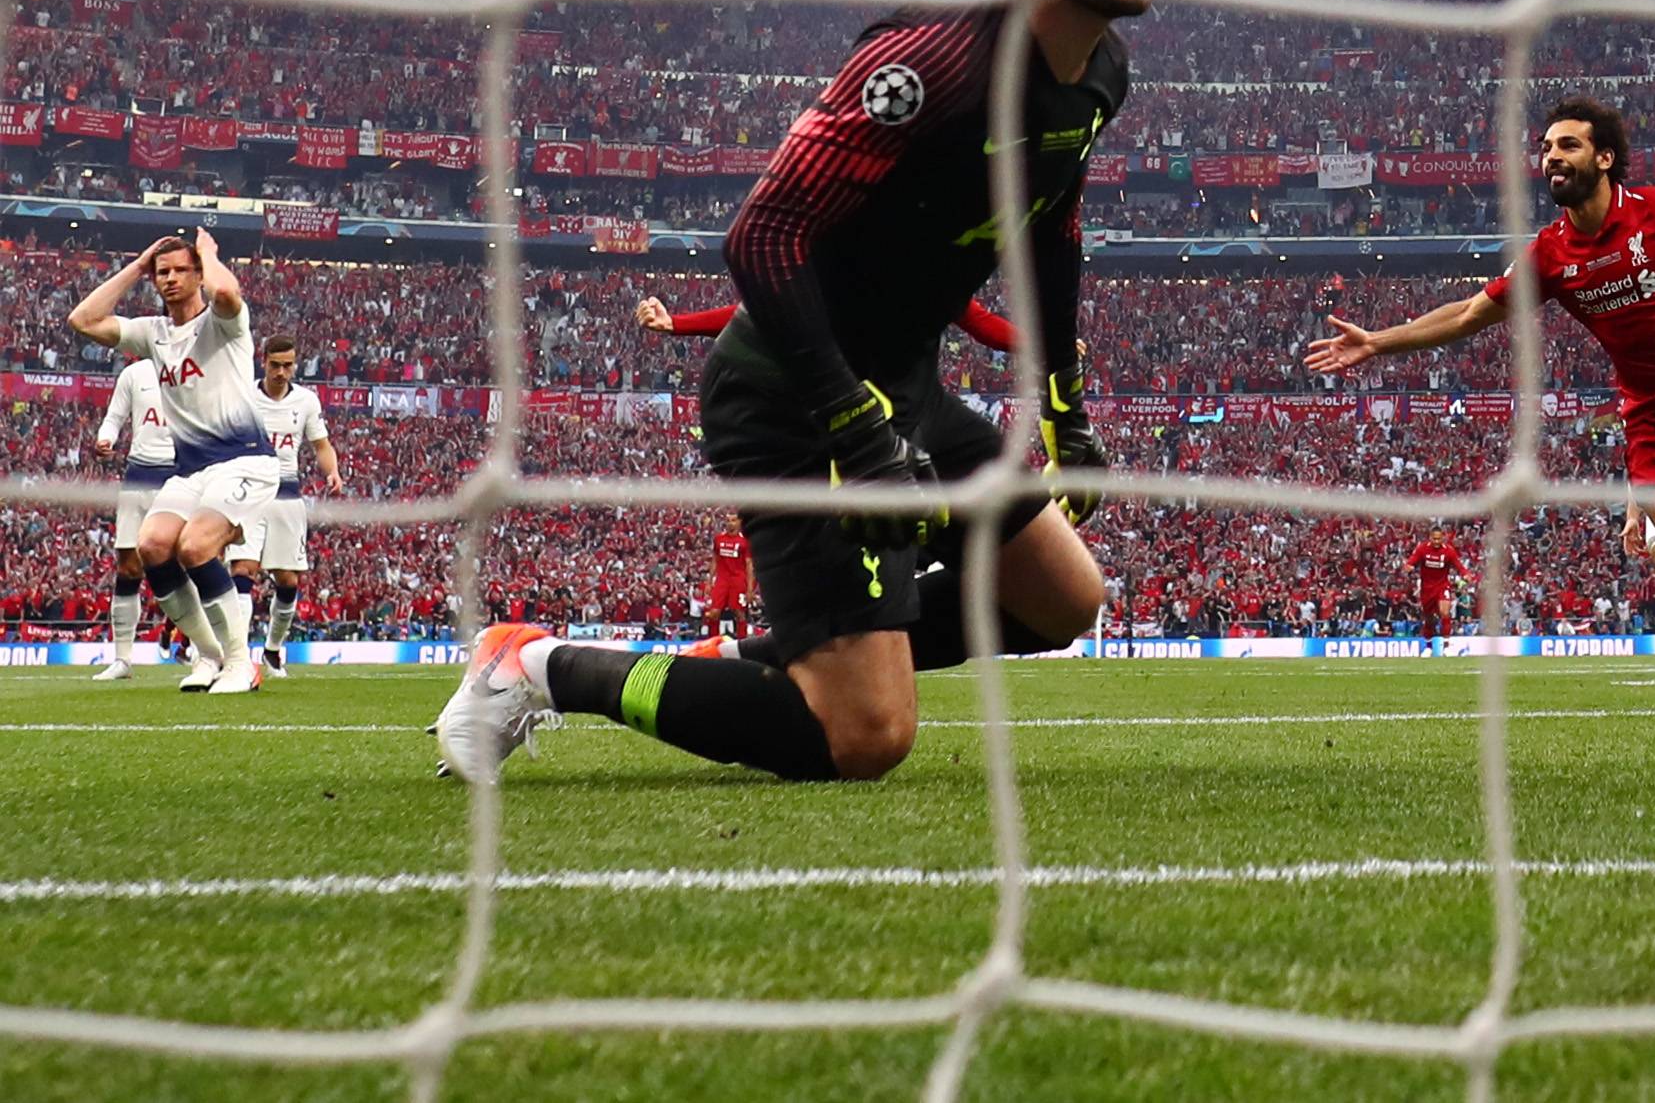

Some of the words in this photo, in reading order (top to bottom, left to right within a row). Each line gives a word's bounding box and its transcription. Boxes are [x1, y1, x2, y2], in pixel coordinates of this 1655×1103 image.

[302, 132, 317, 141] ALL
[384, 148, 404, 158] THE
[407, 149, 437, 159] GLORY
[1146, 158, 1161, 170] 66
[1412, 158, 1527, 175] CONQUISTADS
[612, 228, 632, 240] DIY
[1631, 254, 1651, 267] LFC
[1574, 274, 1634, 302] Standard
[24, 373, 74, 387] WAZZAS
[1132, 396, 1168, 405] FORZA
[1121, 404, 1178, 413] LIVERPOOL
[232, 477, 253, 502] 5
[1105, 641, 1201, 659] GAZPROM
[1325, 640, 1420, 658] GAZPROM
[1541, 638, 1634, 657] GAZPROM
